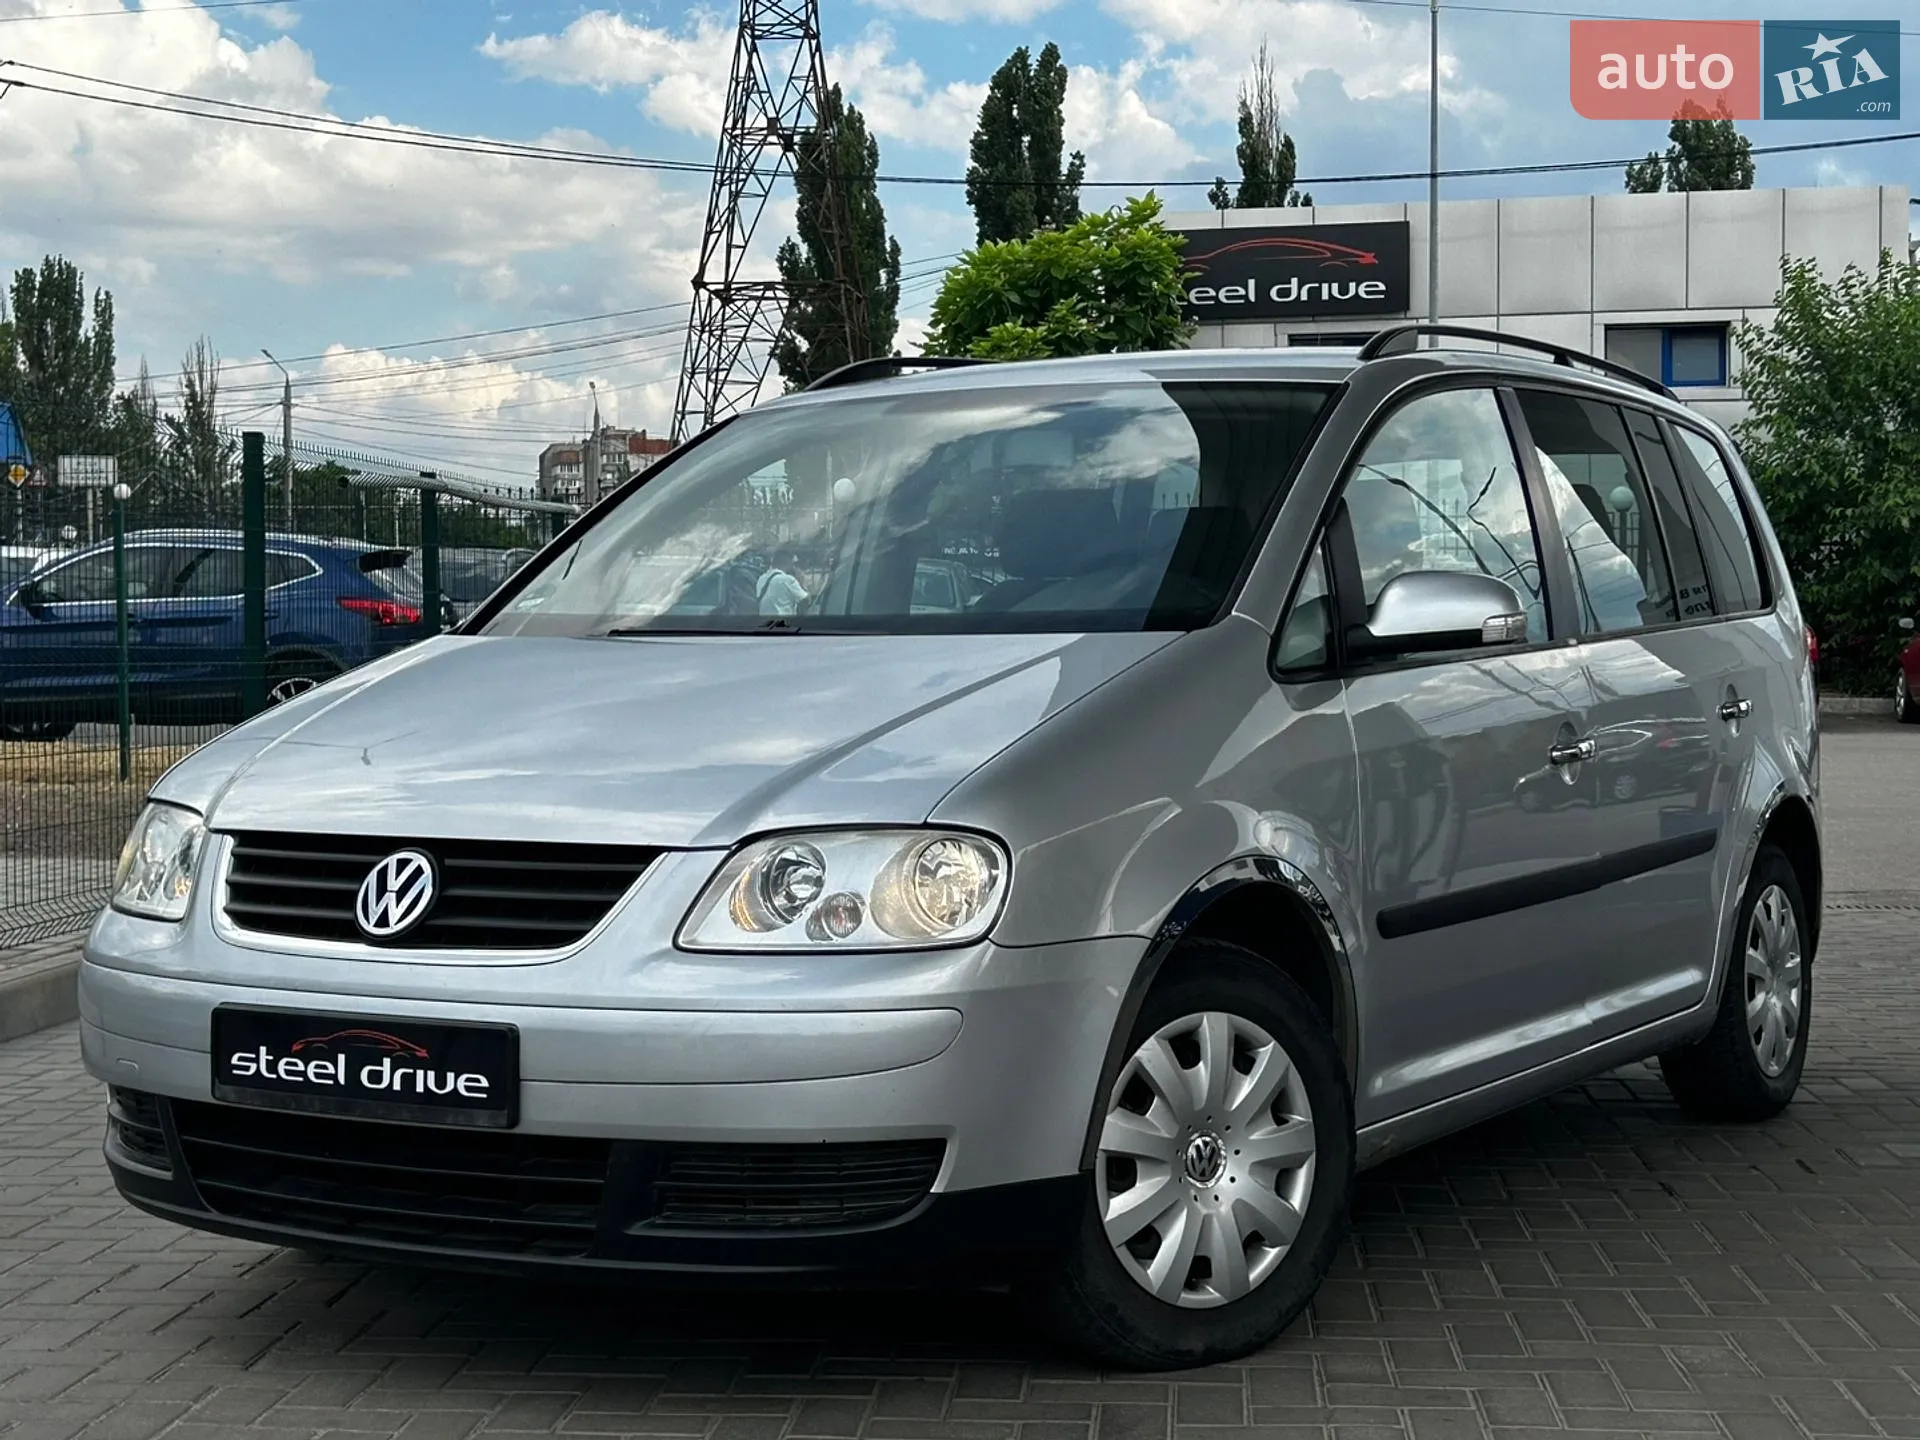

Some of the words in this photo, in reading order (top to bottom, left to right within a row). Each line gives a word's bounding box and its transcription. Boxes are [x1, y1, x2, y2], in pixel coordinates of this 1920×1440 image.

[1175, 278, 1256, 306] eel
[1269, 277, 1387, 302] drive
[231, 1046, 345, 1086] steel
[360, 1057, 490, 1099] drive
